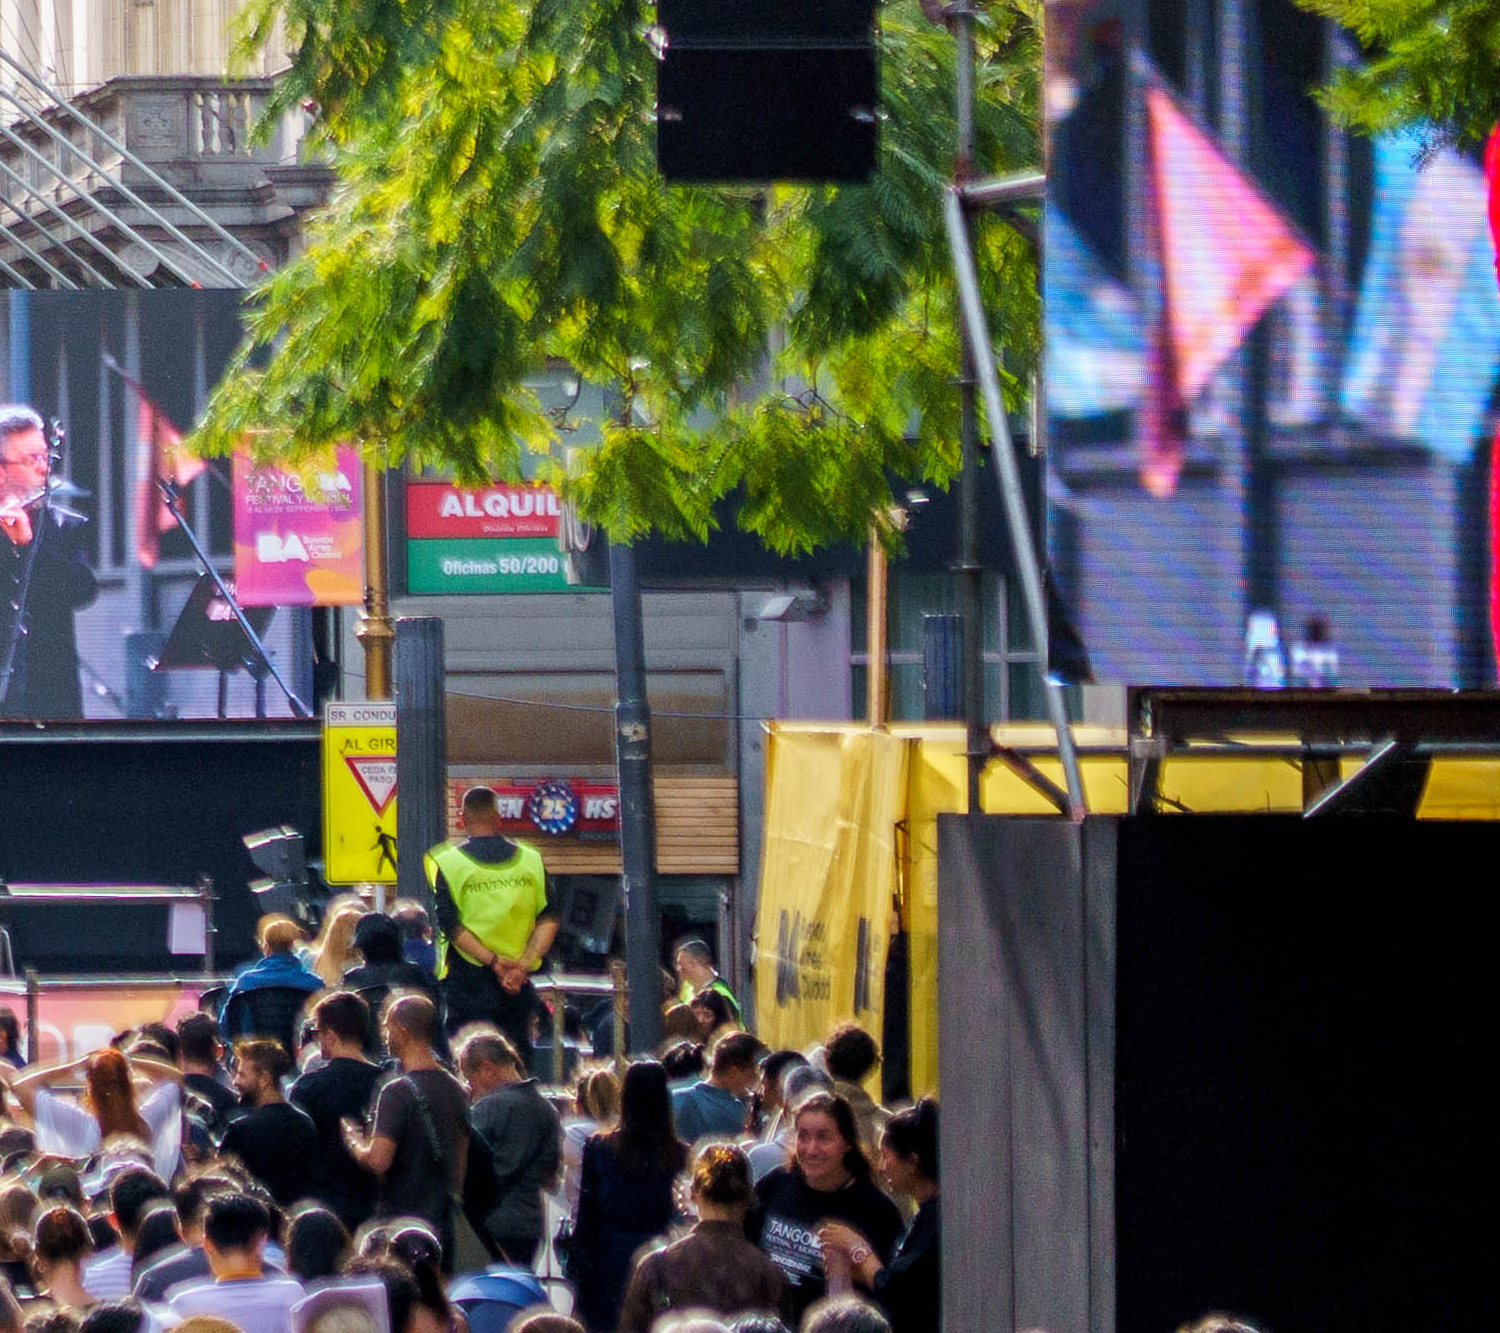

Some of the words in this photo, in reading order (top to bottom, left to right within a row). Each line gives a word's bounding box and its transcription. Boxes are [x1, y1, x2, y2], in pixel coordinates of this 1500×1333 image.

[257, 532, 310, 563] BA
[443, 559, 498, 575] Oficinas
[500, 556, 559, 574] 50/200
[331, 710, 347, 721] SR
[344, 738, 364, 751] AL
[541, 796, 566, 820] 25
[584, 798, 618, 819] HS
[462, 875, 534, 895] PREVENCIÓN
